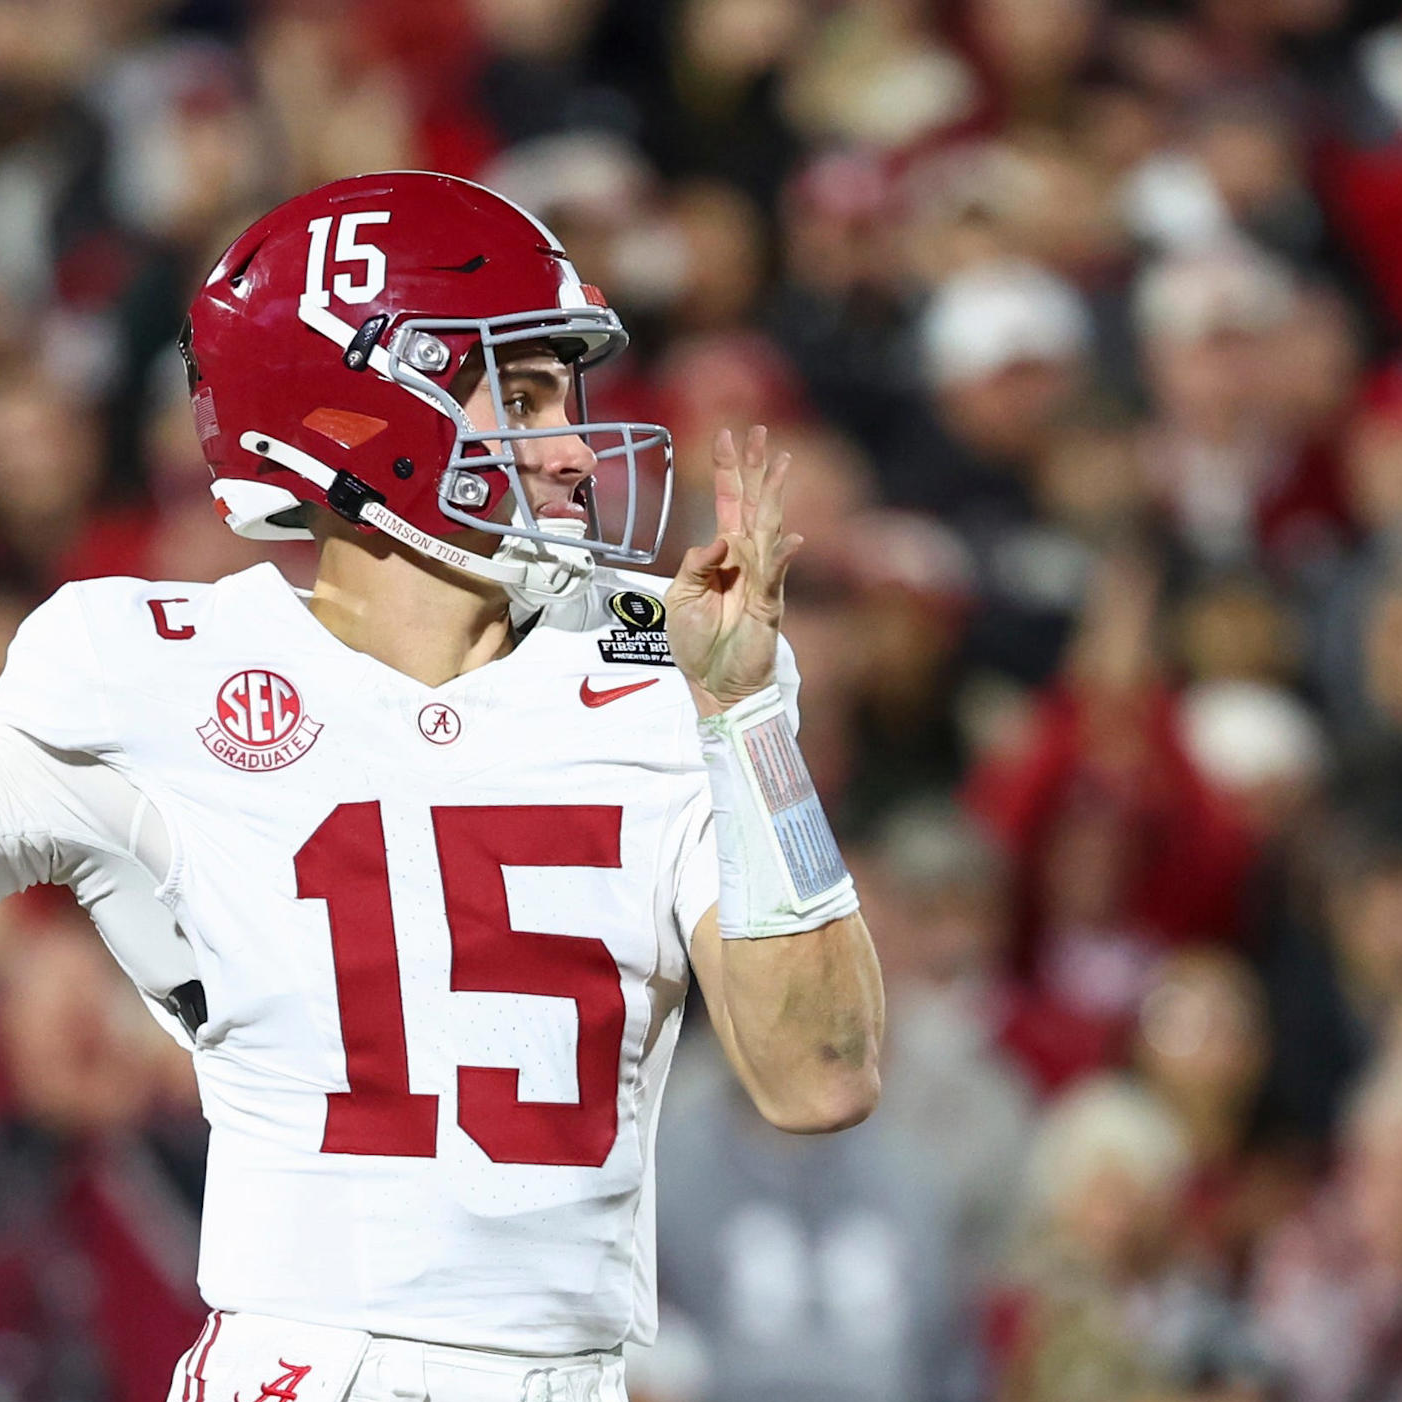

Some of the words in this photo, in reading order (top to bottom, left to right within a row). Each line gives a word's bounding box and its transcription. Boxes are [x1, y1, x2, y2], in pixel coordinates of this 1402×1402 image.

[299, 211, 391, 308] 15
[364, 503, 432, 551] CRIMSON
[436, 544, 470, 568] TIDE
[601, 641, 647, 652] FIRST
[221, 673, 296, 742] SEC
[212, 736, 307, 769] GRADUATE
[292, 800, 626, 1167] 15
